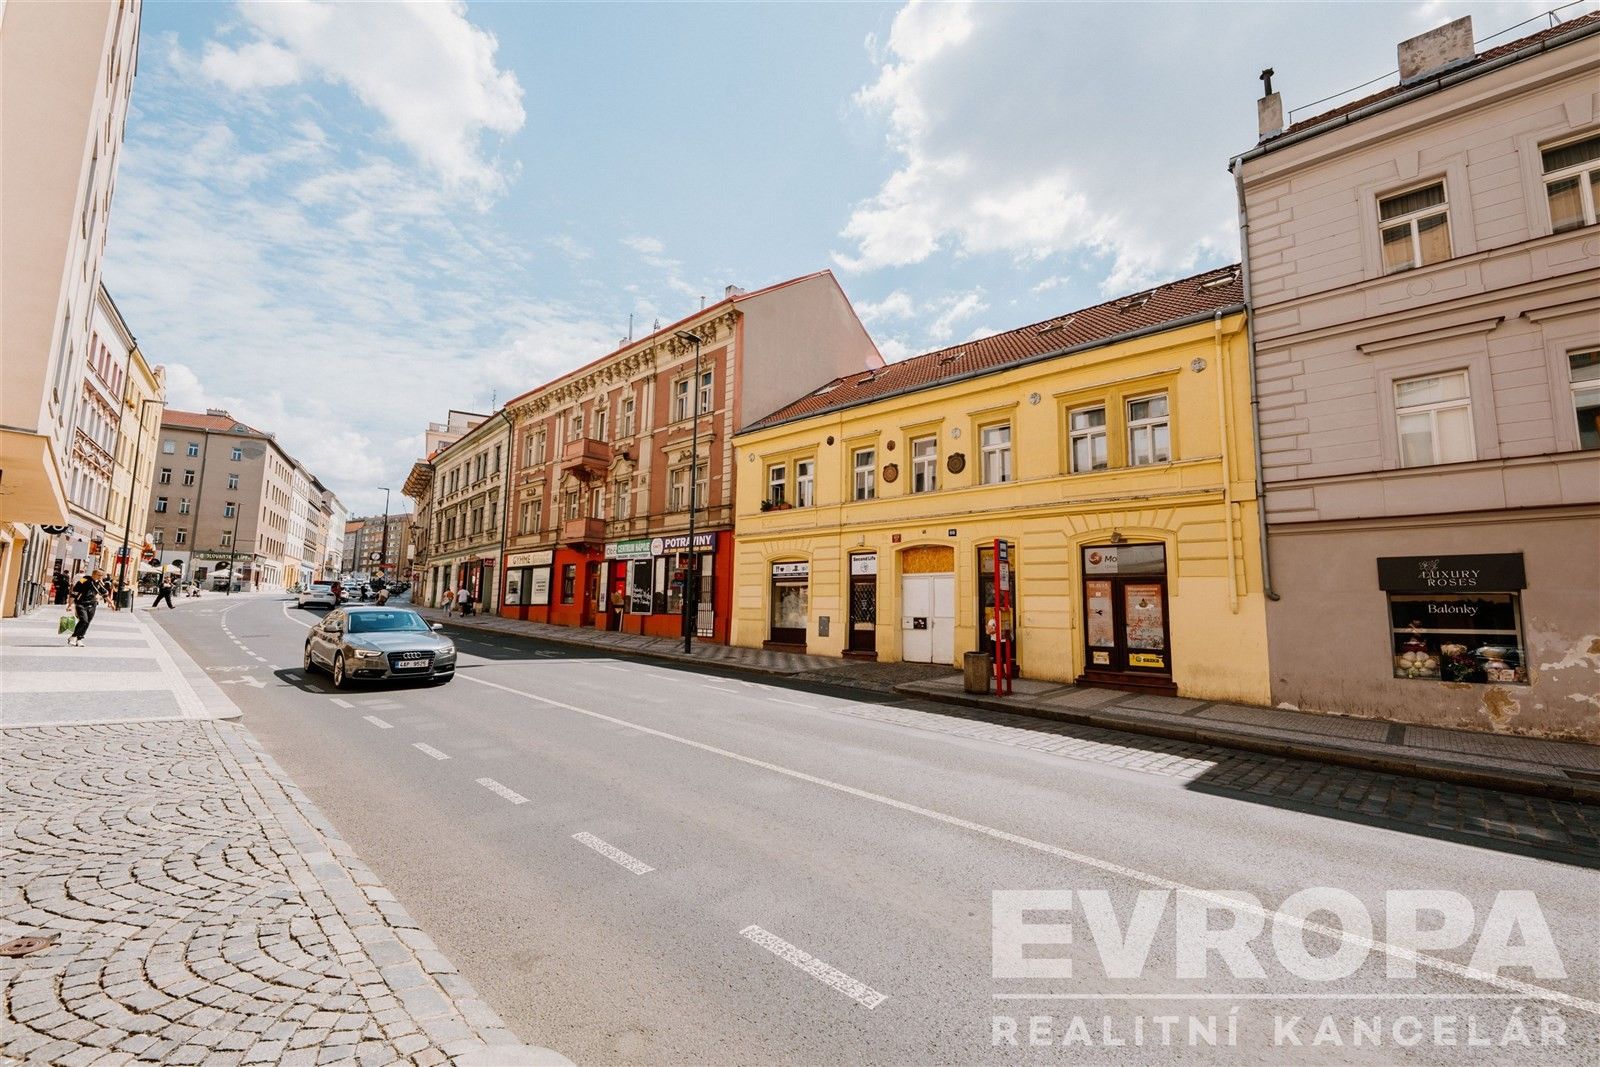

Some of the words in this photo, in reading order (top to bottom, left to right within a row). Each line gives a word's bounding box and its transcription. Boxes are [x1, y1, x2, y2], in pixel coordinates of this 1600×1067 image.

[1421, 570, 1480, 579] LUXURY
[1427, 578, 1477, 587] ROSES
[1428, 603, 1479, 617] Balónky
